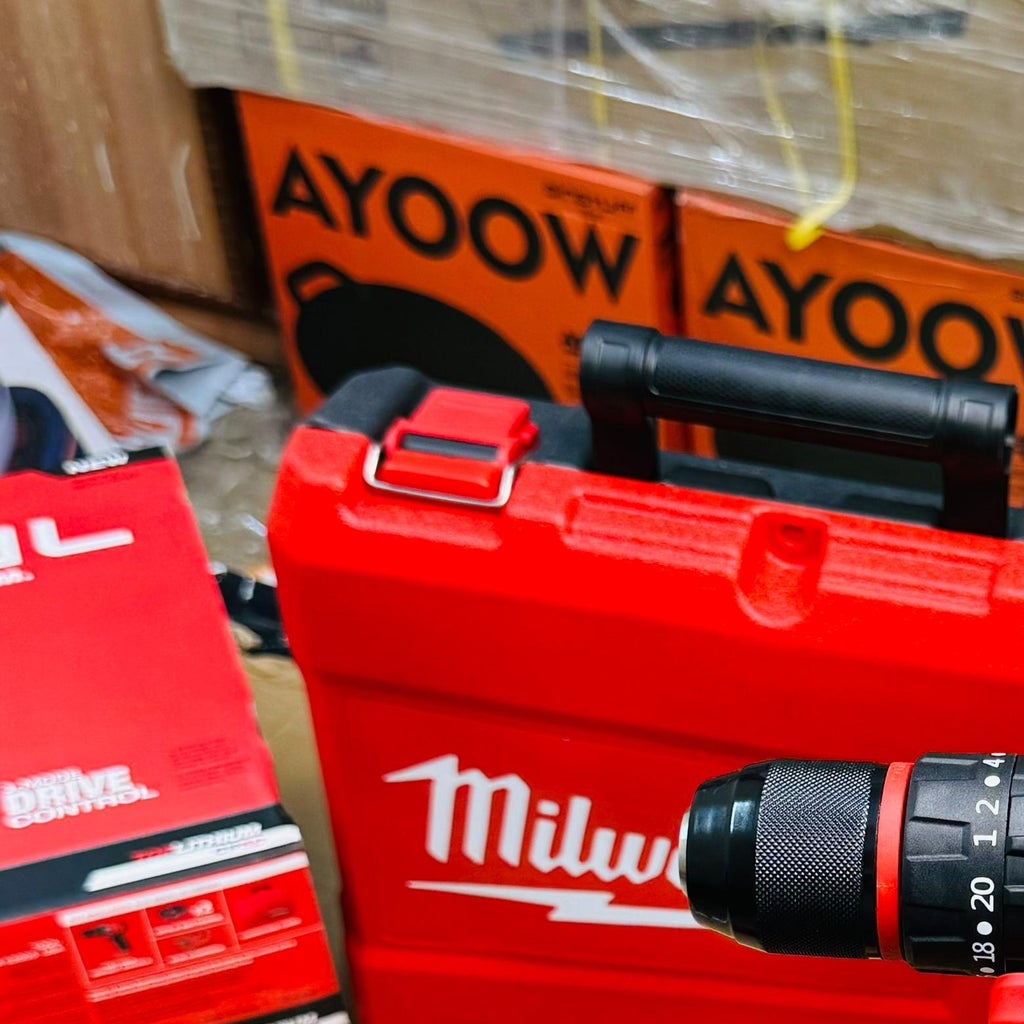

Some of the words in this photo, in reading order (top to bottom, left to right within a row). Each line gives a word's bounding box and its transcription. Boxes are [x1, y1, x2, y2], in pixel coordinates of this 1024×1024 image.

[271, 146, 641, 303] AYOOW
[4, 765, 132, 817] DRIVE
[975, 800, 1000, 815] 2
[383, 754, 682, 889] Milw
[973, 830, 998, 847] 1
[970, 877, 995, 912] 20
[972, 942, 995, 962] 18
